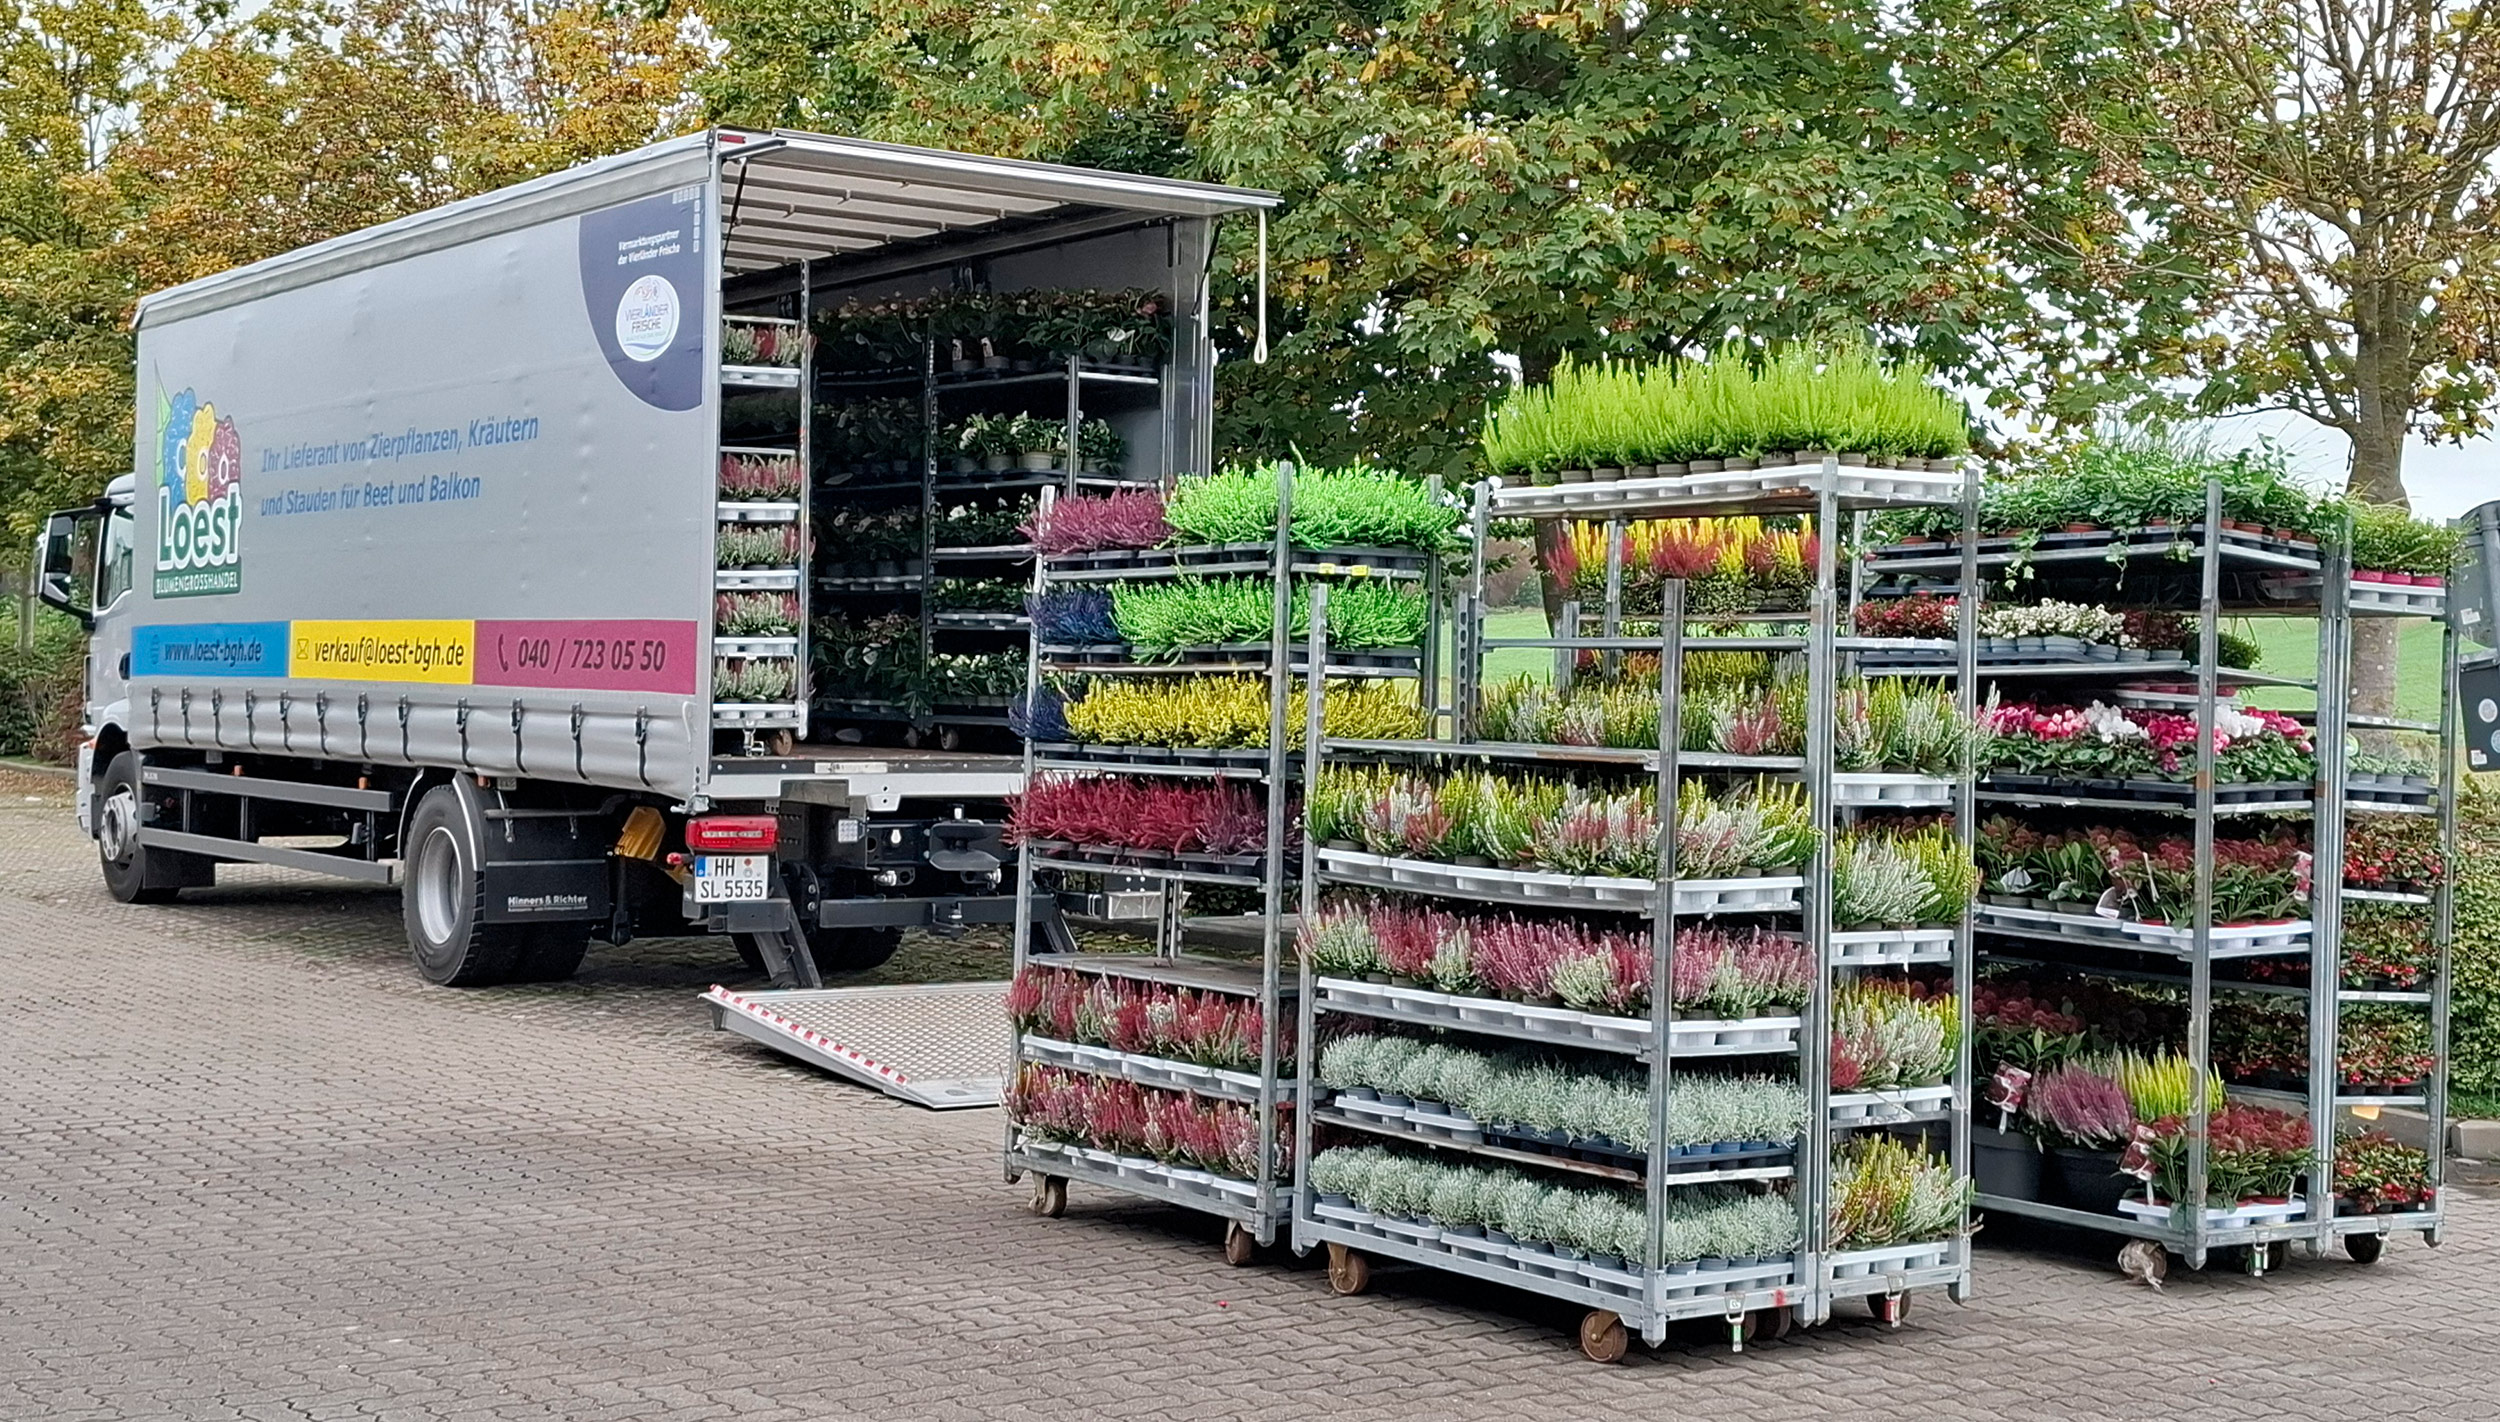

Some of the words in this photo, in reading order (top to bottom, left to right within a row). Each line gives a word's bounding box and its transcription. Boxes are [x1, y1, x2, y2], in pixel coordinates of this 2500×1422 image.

[632, 317, 661, 333] FRISCHE
[262, 448, 280, 472] Ihr
[283, 440, 339, 469] Lieferant
[343, 440, 366, 462] von
[369, 427, 463, 462] Zierpflanzen,
[468, 415, 539, 447] Kräutern
[261, 490, 283, 516] und
[286, 486, 336, 514] Stauden
[341, 484, 360, 509] für
[364, 480, 394, 507] Beet
[398, 475, 426, 504] und
[430, 472, 481, 502] Balkon
[160, 491, 239, 561] Loest
[156, 572, 238, 594] BLUMENGROSSHANDEL
[164, 637, 262, 667] www.loest-bgh.de
[314, 636, 464, 672] verkauf@loest-bgh.de
[518, 639, 550, 669] 040
[553, 638, 566, 675] /
[571, 639, 606, 670] 723
[611, 640, 636, 671] 05
[640, 640, 666, 672] 50
[715, 858, 736, 877] HH
[553, 894, 588, 905] Richter
[700, 880, 721, 899] SL
[724, 880, 763, 898] 5535
